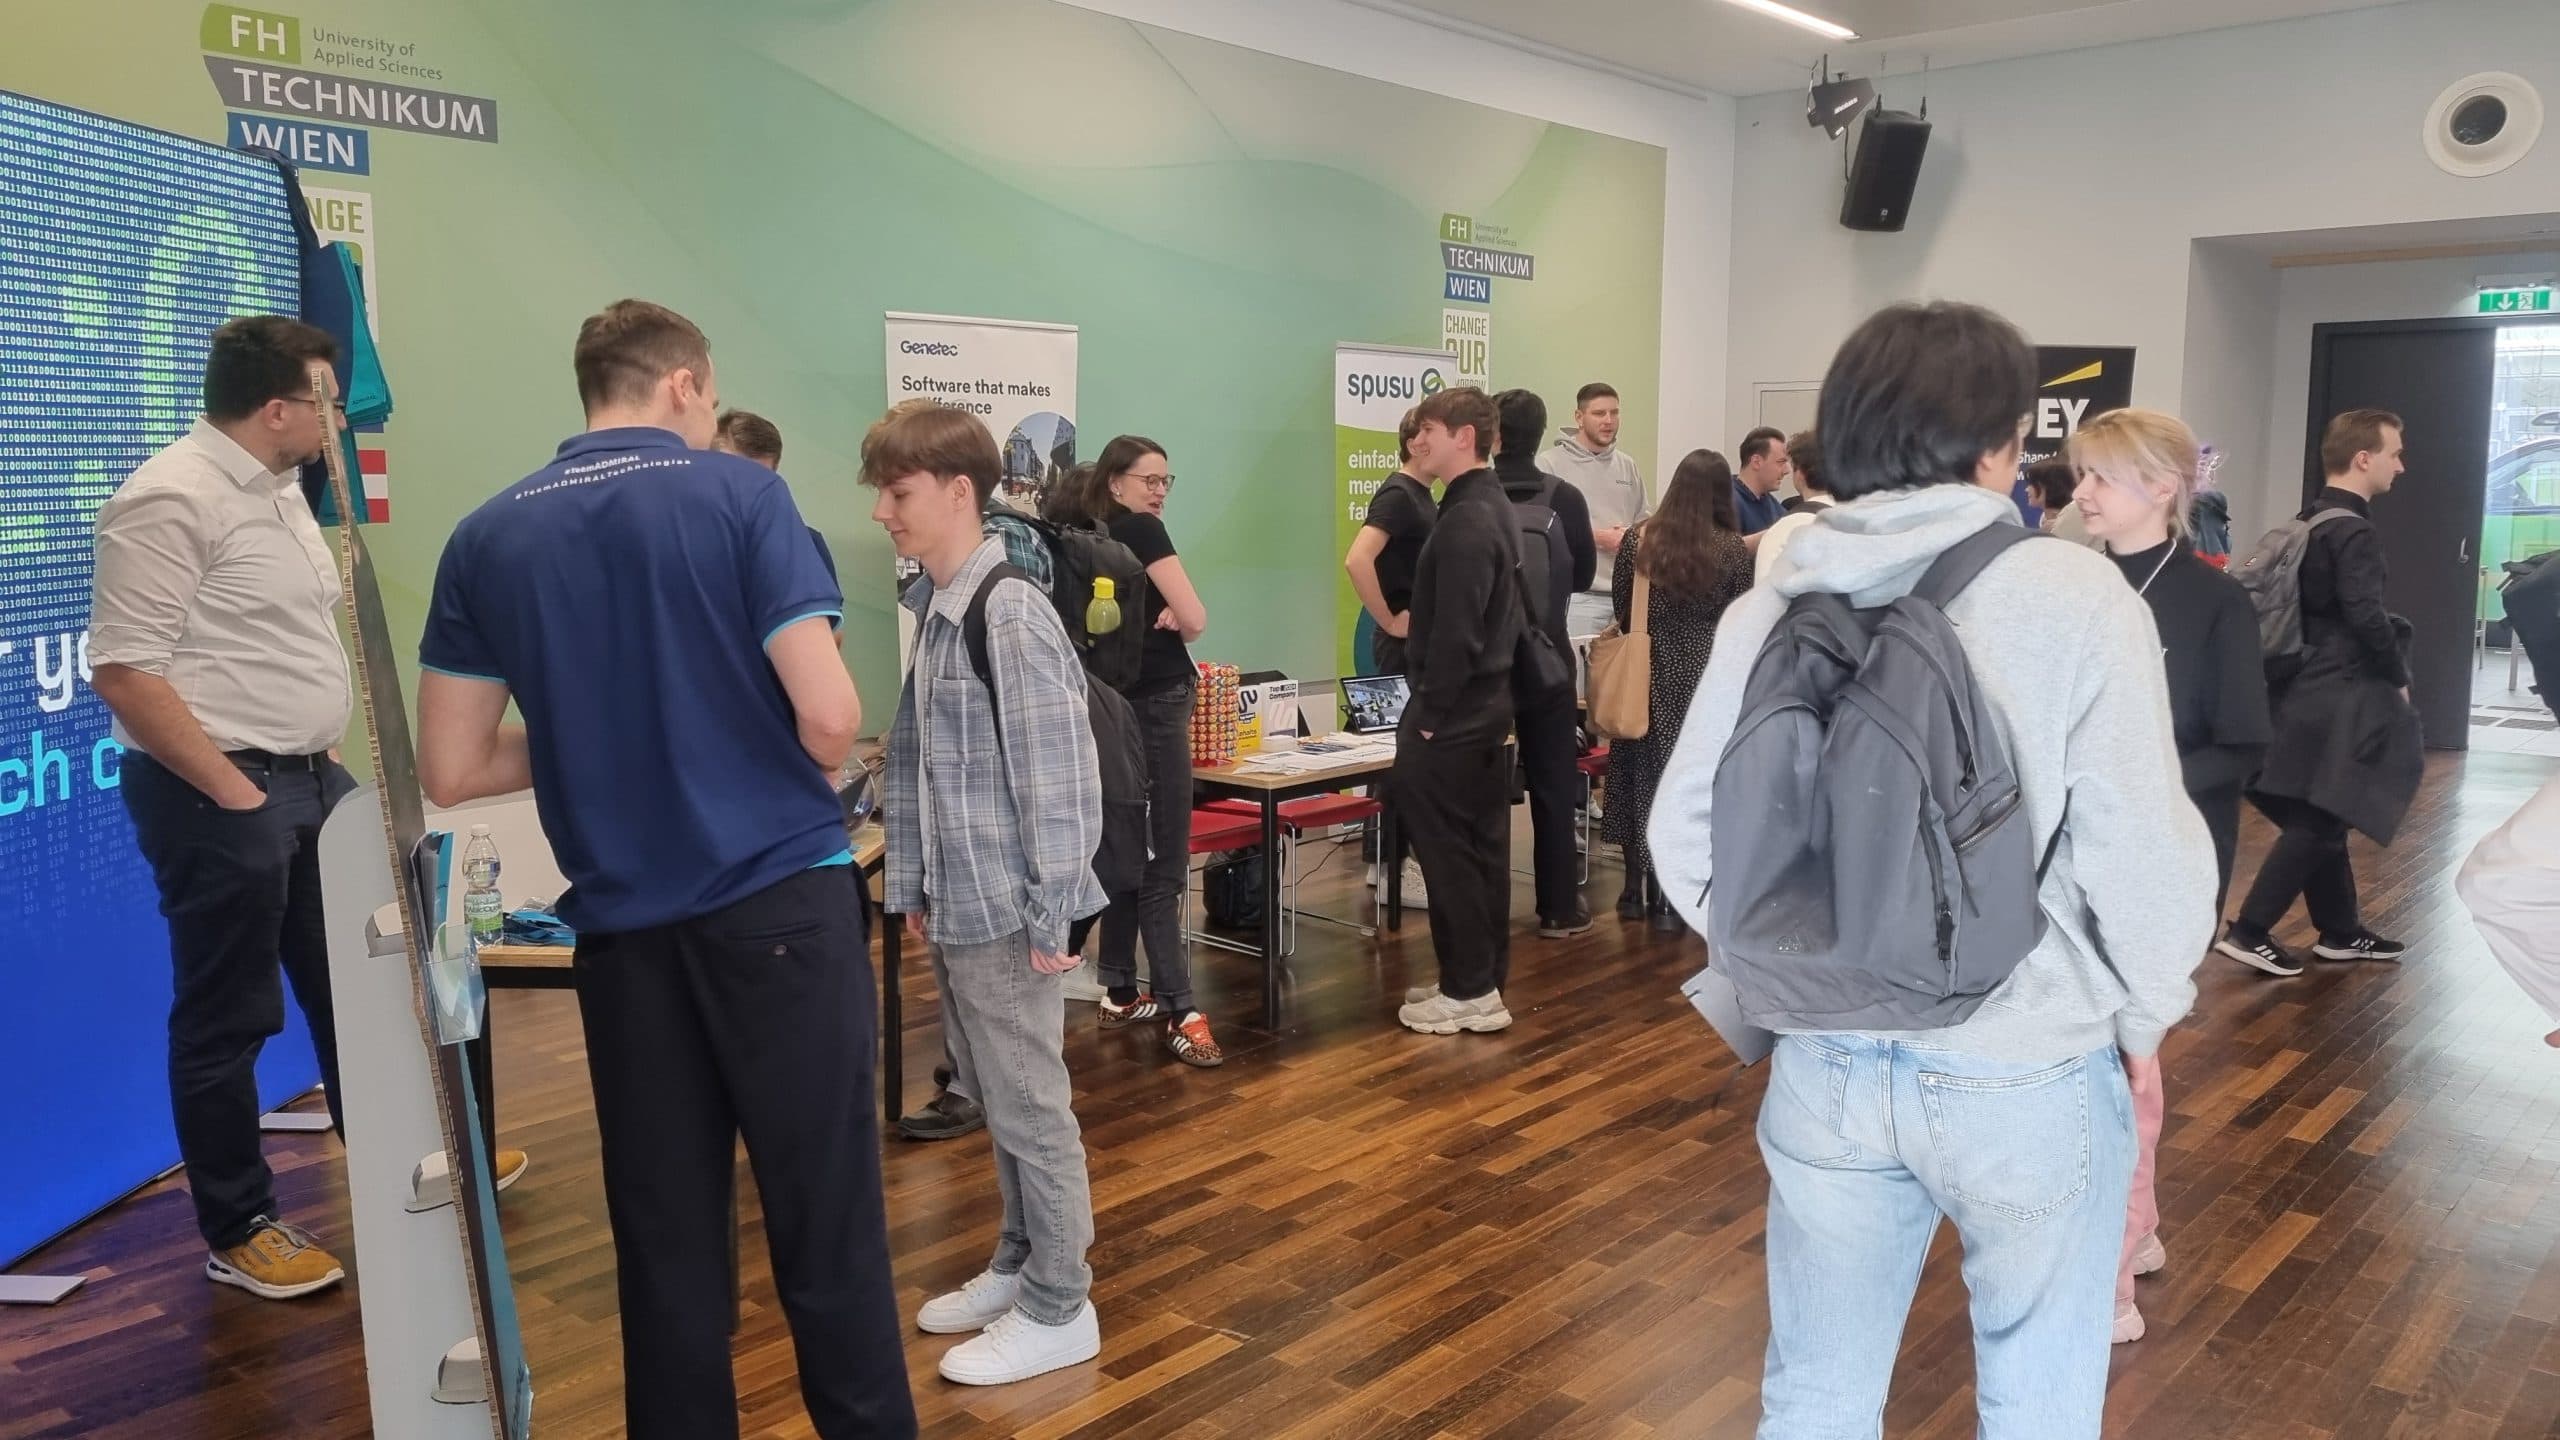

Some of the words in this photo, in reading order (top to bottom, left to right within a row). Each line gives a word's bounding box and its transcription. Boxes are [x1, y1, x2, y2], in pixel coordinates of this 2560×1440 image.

[231, 14, 286, 55] FH
[313, 27, 395, 56] University
[399, 43, 416, 57] of
[314, 48, 375, 70] Applied
[379, 58, 443, 81] Sciences
[233, 67, 485, 136] TECHNIKUM
[241, 121, 356, 168] WIEN
[1450, 218, 1467, 239] FH
[1449, 247, 1530, 277] TECHNIKUM
[1450, 277, 1486, 300] WIEN
[1445, 314, 1487, 337] CHANGE
[900, 340, 959, 357] Genetec
[902, 375, 971, 393] Software
[975, 379, 1003, 395] that
[1008, 381, 1051, 397] makes
[1348, 372, 1414, 404] spusu
[2037, 398, 2090, 438] EY
[1348, 449, 1403, 469] einfach
